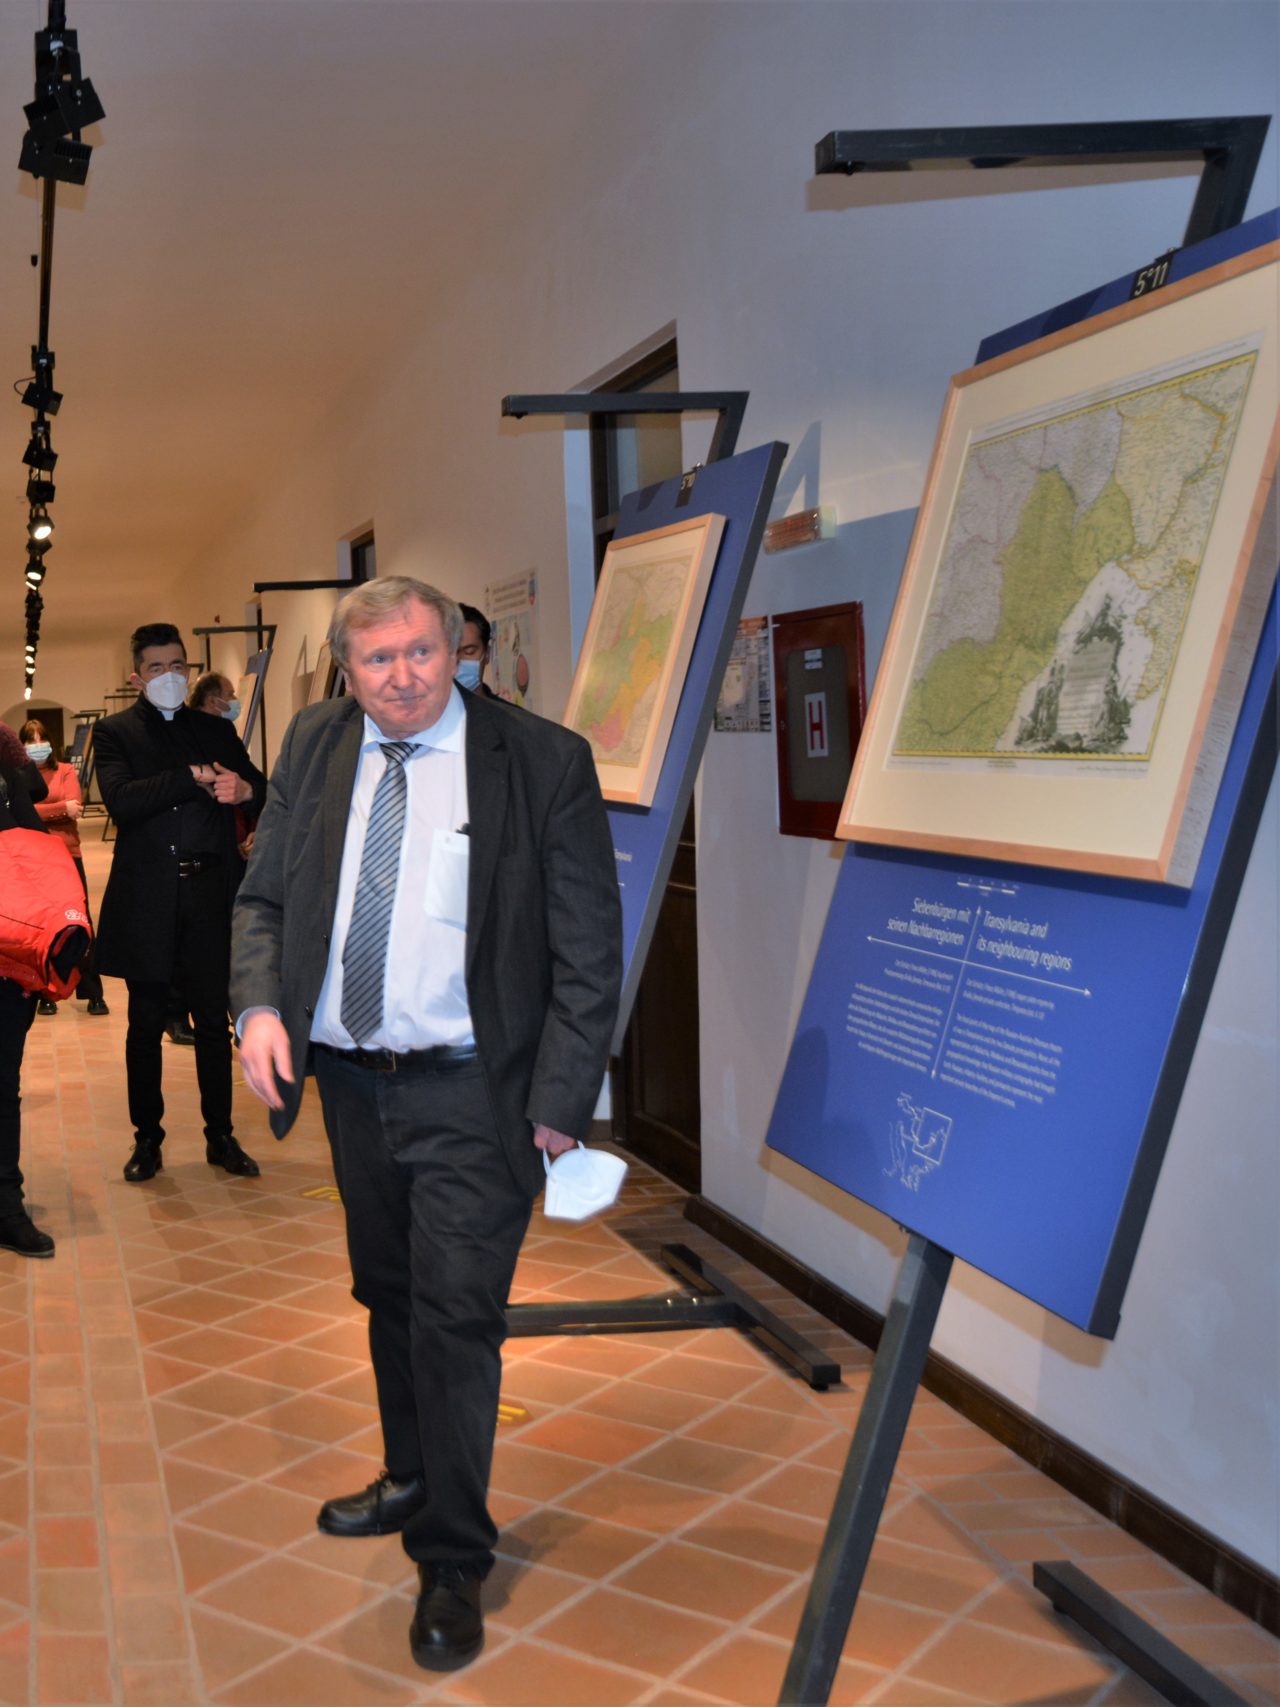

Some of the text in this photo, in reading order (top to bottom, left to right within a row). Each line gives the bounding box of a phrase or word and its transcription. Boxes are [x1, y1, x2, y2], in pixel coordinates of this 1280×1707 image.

[808, 700, 825, 751] H
[911, 897, 972, 924] Siebenbürgen mit
[983, 910, 1050, 939] Transylvania and
[886, 916, 965, 946] seinen Nachbarregionen
[976, 934, 1073, 972] its neighbouring regions
